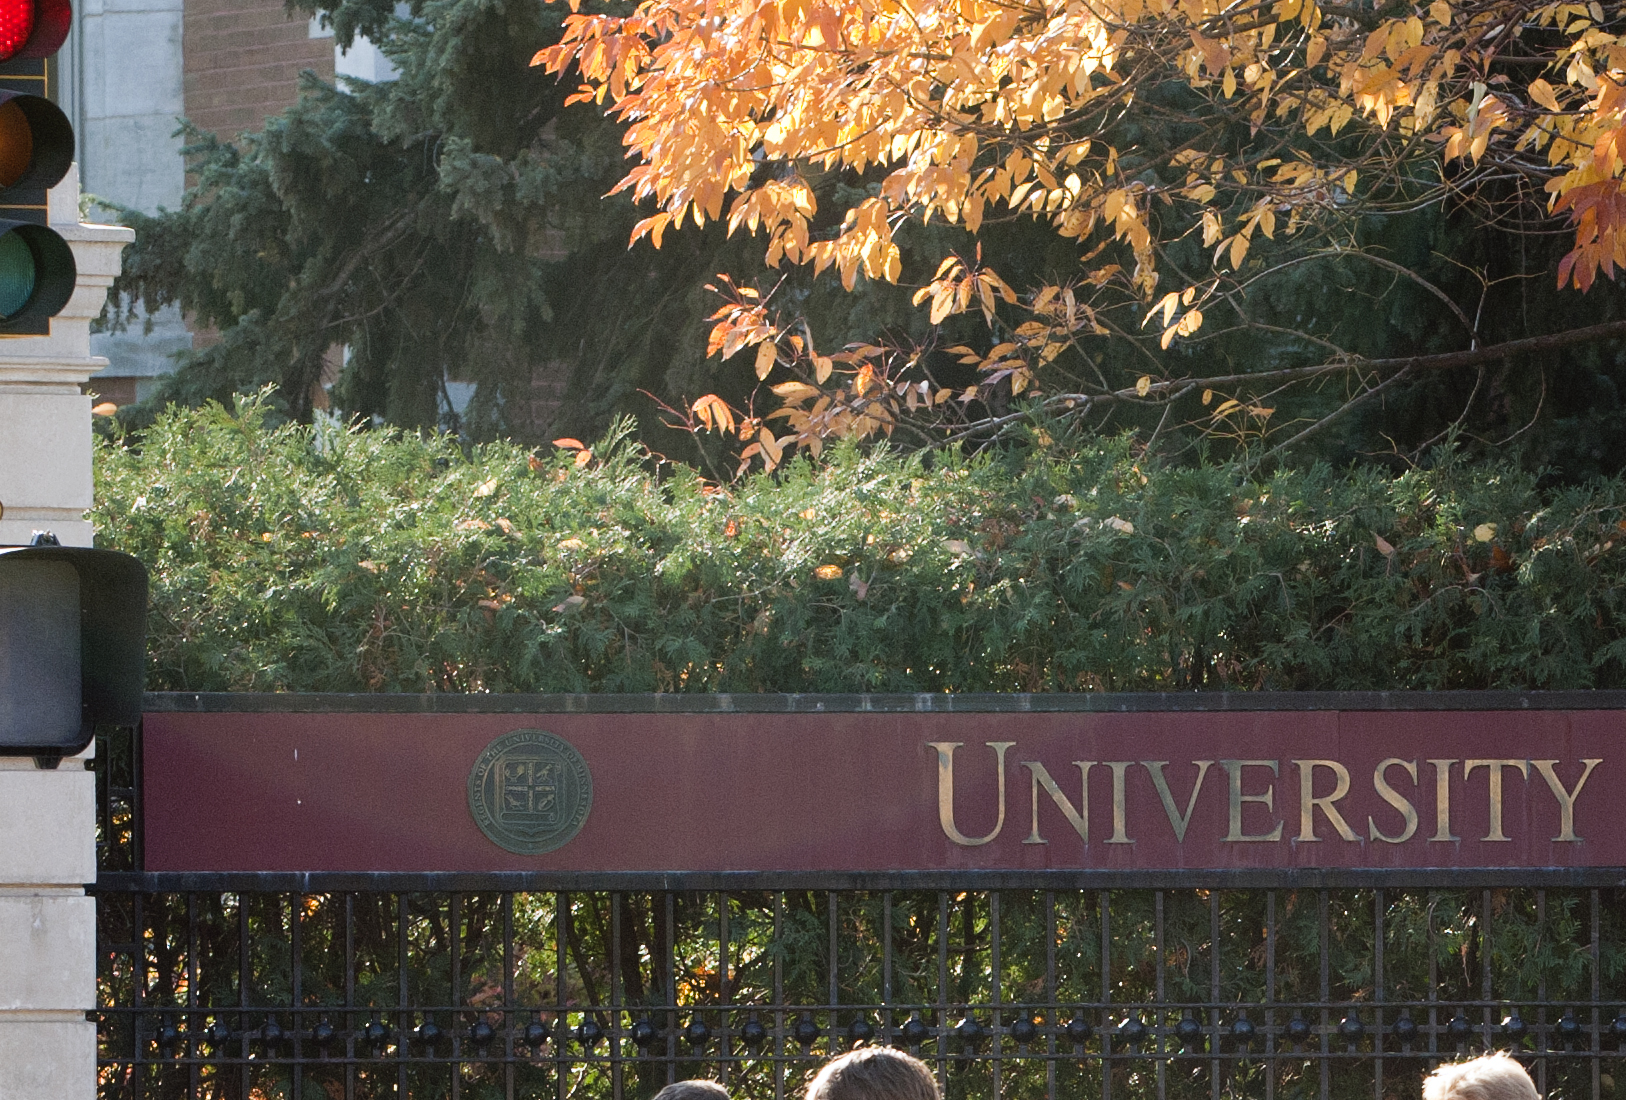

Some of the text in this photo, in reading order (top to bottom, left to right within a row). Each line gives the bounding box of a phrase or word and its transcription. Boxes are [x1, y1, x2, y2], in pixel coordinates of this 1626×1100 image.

[478, 762, 487, 776] OF
[486, 744, 502, 760] THE
[505, 733, 565, 751] UNIVERSITY
[926, 740, 1603, 847] UNIVERSITY
